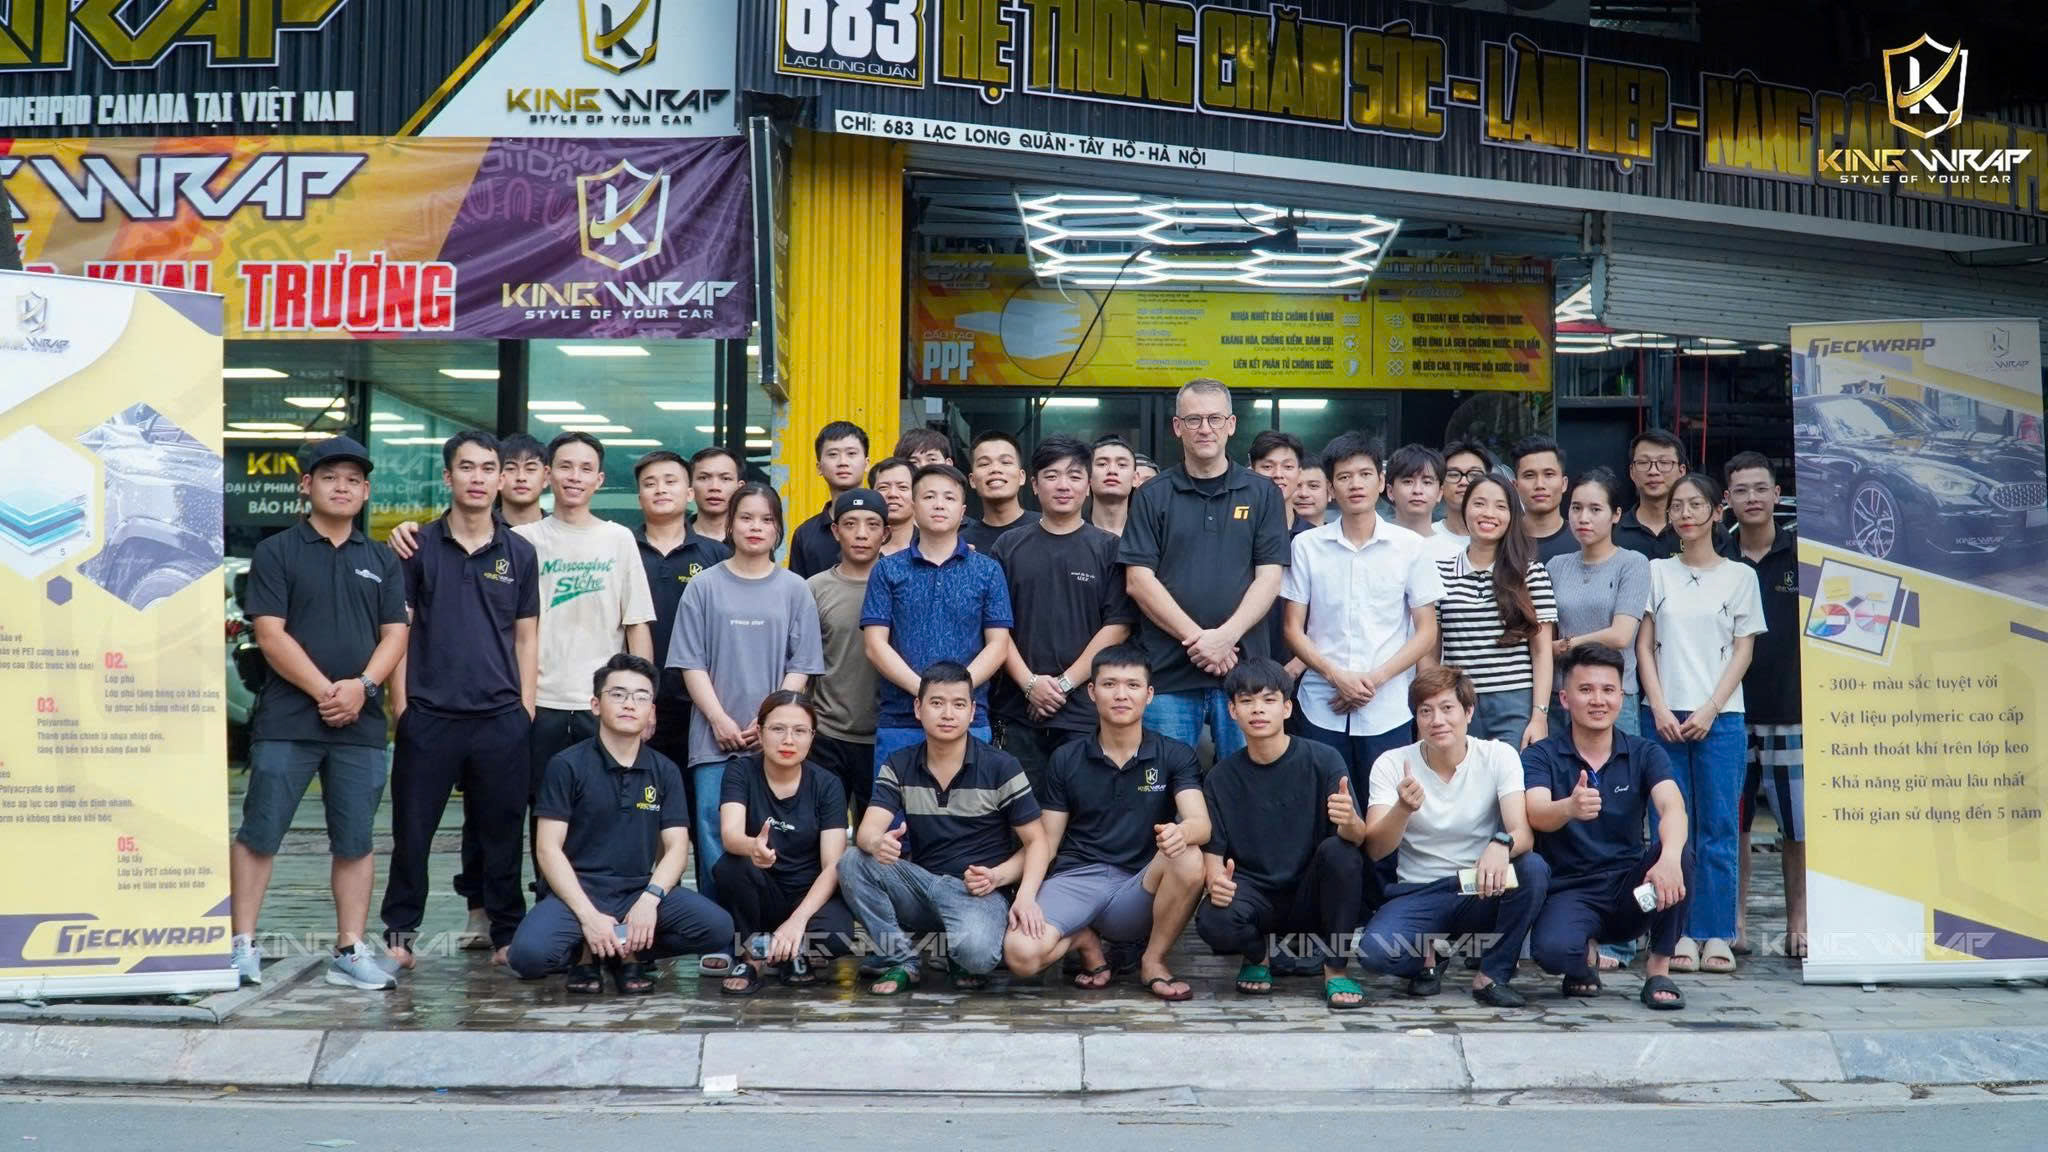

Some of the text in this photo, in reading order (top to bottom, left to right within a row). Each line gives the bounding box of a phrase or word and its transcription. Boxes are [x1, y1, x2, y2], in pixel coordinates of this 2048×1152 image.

[784, 54, 916, 79] LẠC LONG QUÂN
[98, 93, 189, 124] CANADA
[194, 92, 232, 129] TẠI
[241, 86, 296, 129] VIỆT
[303, 91, 354, 122] NAM
[506, 88, 731, 112] KING WRAP
[530, 115, 692, 125] STYLE OF YOUR CAR
[884, 119, 914, 136] 683
[924, 124, 956, 142] LẠC
[966, 128, 1011, 145] LONG
[1020, 131, 1066, 151] QUÂN
[1079, 136, 1104, 154] TÂY
[1149, 145, 1170, 162] HÀ
[1179, 148, 1206, 168] NỘI
[239, 250, 457, 332] TRƯƠNG
[502, 281, 738, 308] KING WRAP
[525, 309, 714, 320] STYLE OF YOUR CAR
[923, 341, 975, 381] PPF
[247, 452, 302, 476] KIN
[263, 482, 294, 494] PHIM
[105, 652, 128, 669] 02.
[1829, 678, 1867, 690] 300+
[1873, 677, 1903, 690] màu
[1908, 674, 1930, 689] sắc
[1936, 676, 1972, 692] tuyệt
[37, 697, 59, 713] 03.
[1830, 706, 2024, 727] Vật liệu polymeric cao cấp
[1831, 740, 2029, 758] Rãnh thoát khí trên lớp keo
[1831, 775, 1860, 789] Khả
[1865, 776, 1900, 791] năng
[1931, 775, 1962, 788] màu
[1967, 774, 1988, 787] lâu
[1993, 771, 2025, 787] nhất
[1833, 807, 1864, 821] Thời
[1870, 807, 1900, 824] gian
[1925, 806, 1961, 824] dụng
[1965, 804, 1992, 820] đến
[1999, 807, 2005, 819] 5
[2011, 806, 2042, 820] năm
[117, 837, 139, 852] 05.
